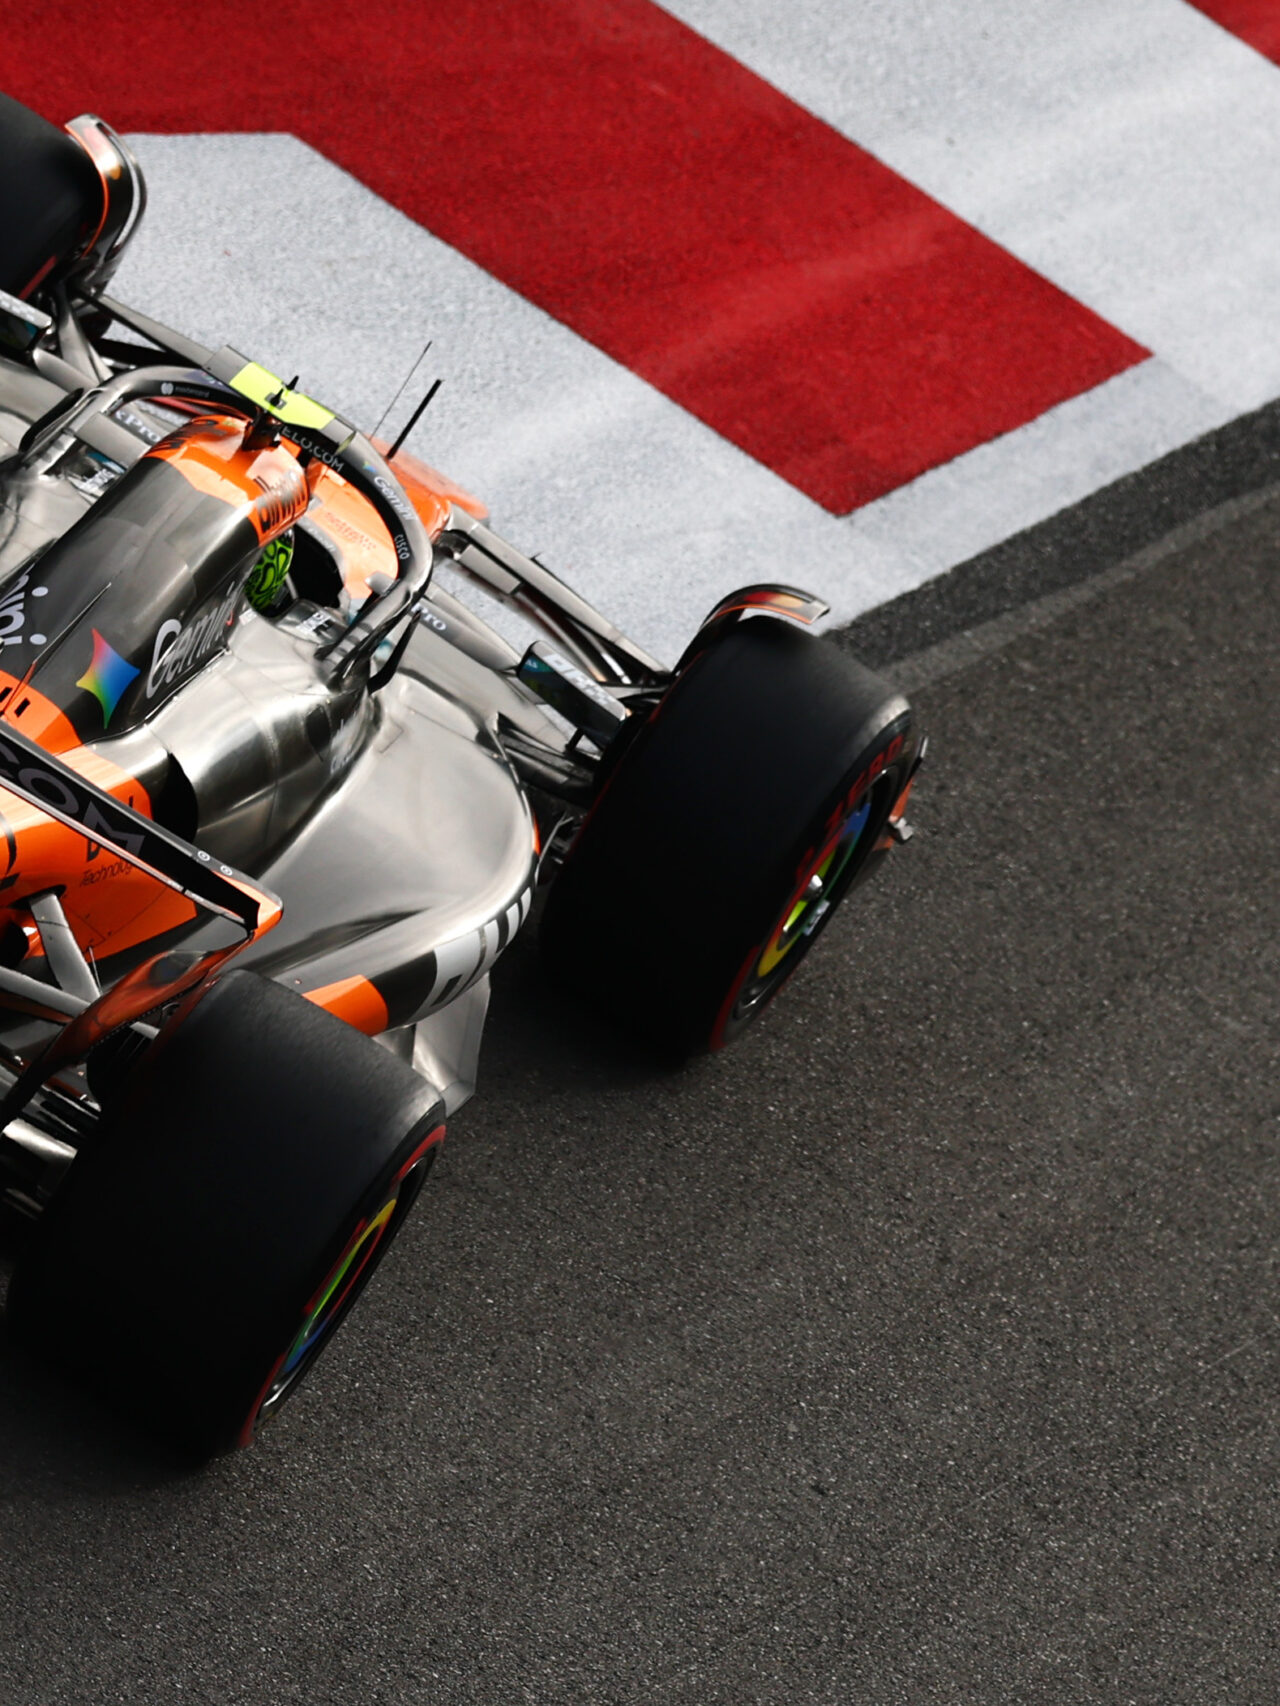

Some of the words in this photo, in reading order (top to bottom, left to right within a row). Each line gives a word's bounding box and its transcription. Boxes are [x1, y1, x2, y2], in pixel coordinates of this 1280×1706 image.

[280, 425, 345, 472] ELO.COM
[373, 475, 417, 521] Gemini
[393, 534, 410, 560] CISCO
